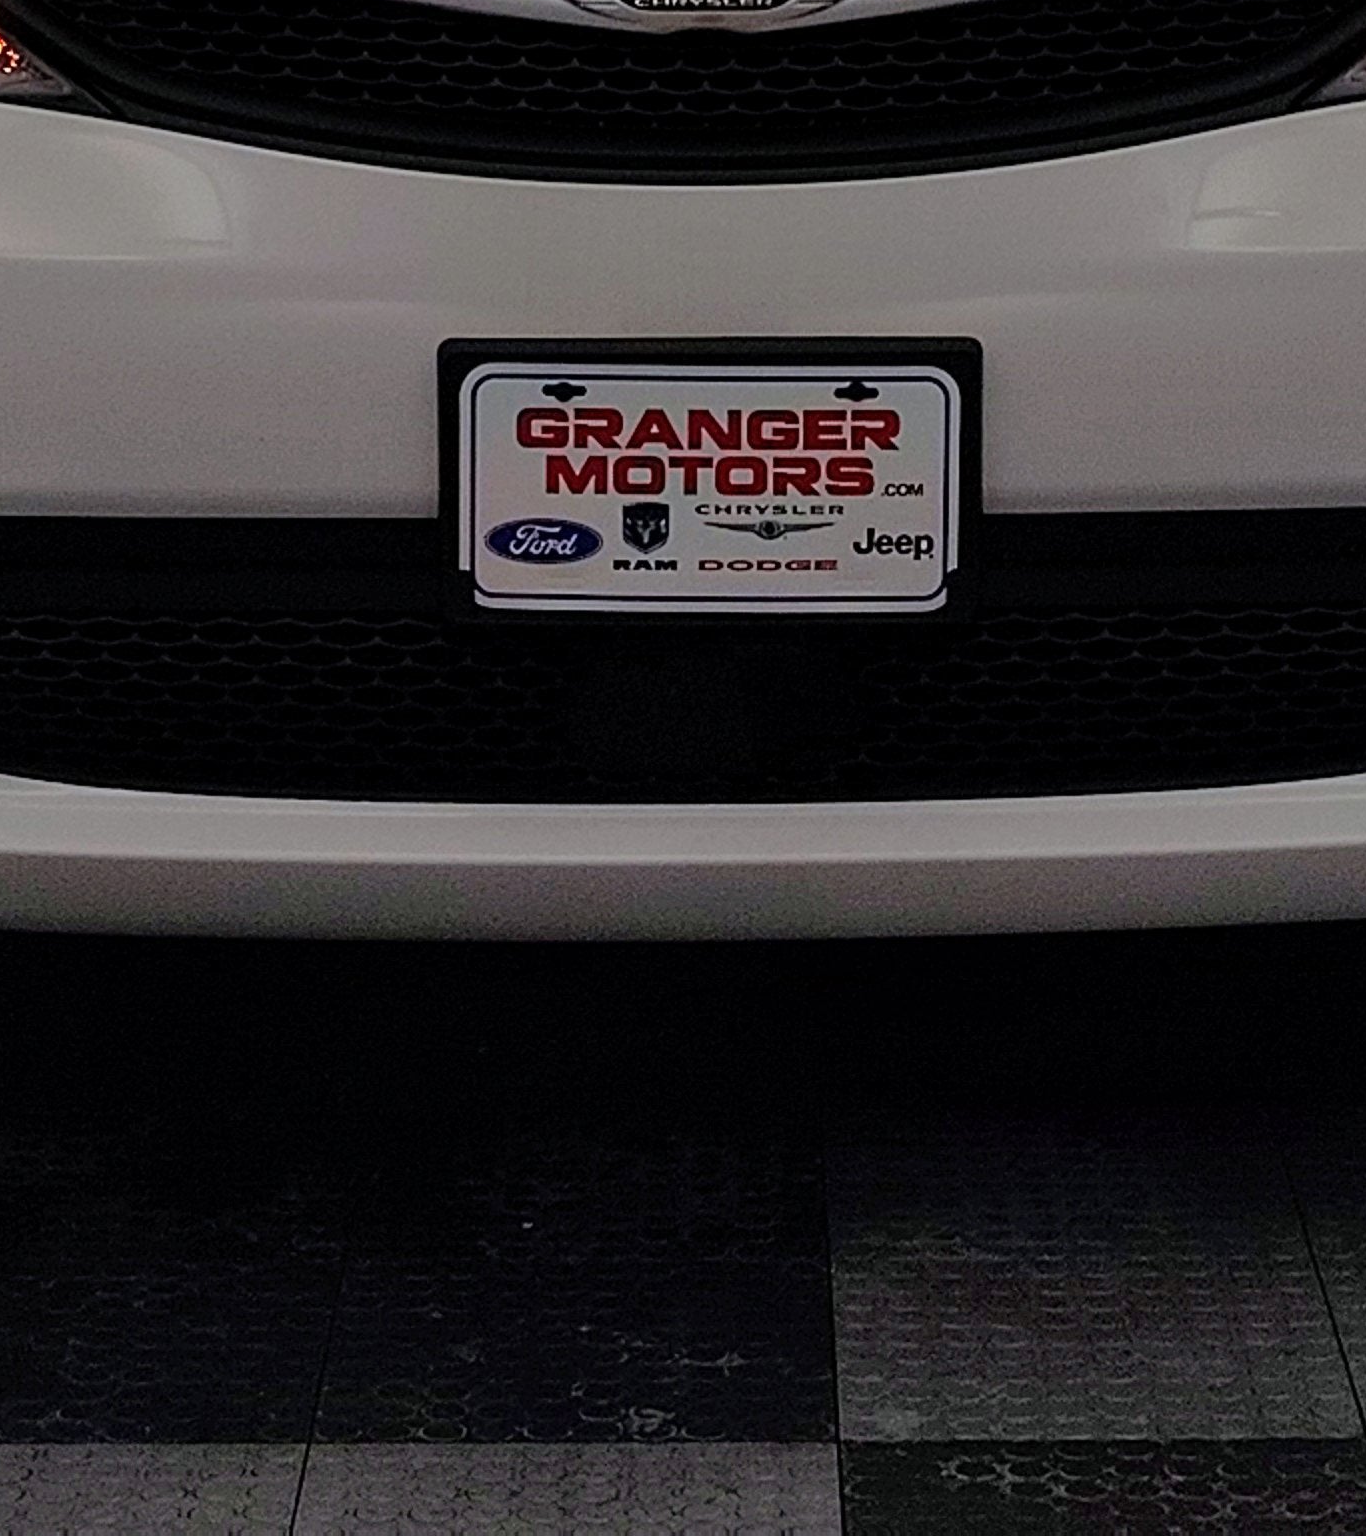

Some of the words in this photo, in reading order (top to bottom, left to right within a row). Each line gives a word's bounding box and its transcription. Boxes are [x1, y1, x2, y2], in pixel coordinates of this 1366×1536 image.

[516, 407, 901, 451] GRANGER
[544, 454, 875, 497] MOTORS
[694, 503, 845, 516] CHRYSLER
[508, 525, 577, 558] Ford
[852, 527, 935, 560] Jeep
[612, 558, 678, 572] RAM
[697, 558, 840, 572] DODGE
